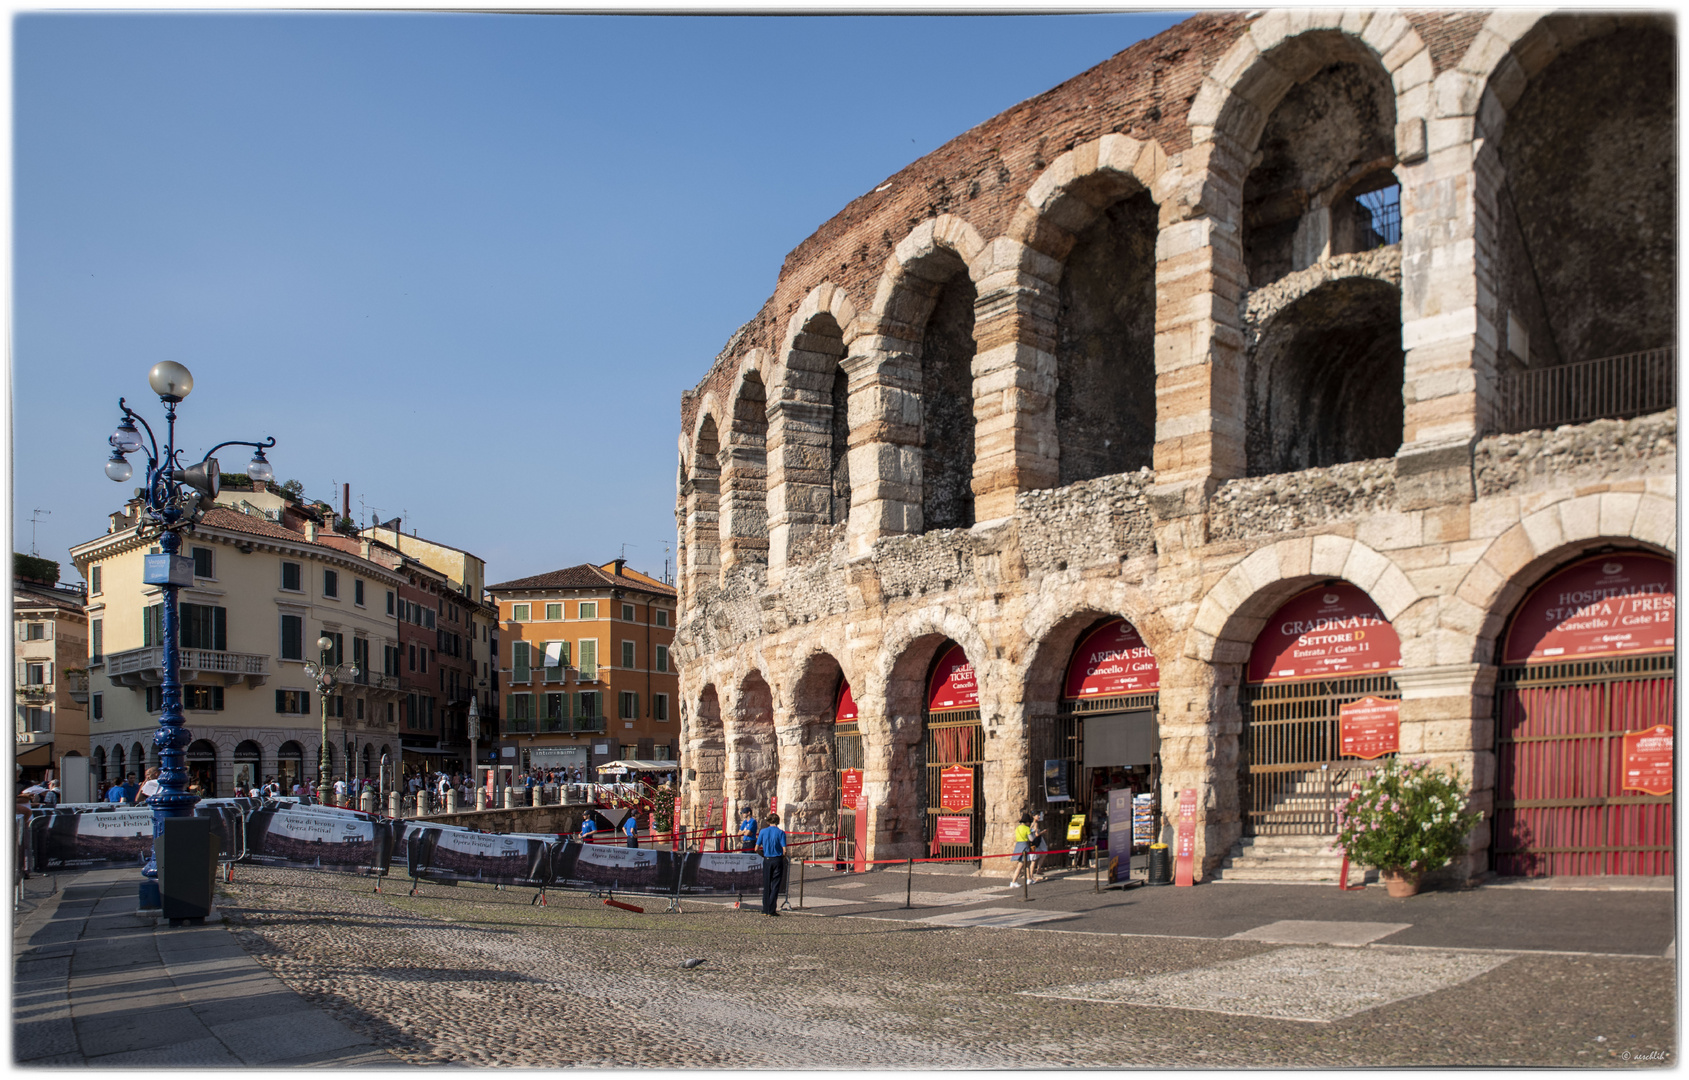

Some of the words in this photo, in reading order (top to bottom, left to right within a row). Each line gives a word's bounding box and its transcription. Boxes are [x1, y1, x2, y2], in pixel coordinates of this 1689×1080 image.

[1559, 583, 1667, 605] HOSPITALITY
[1545, 602, 1612, 621] STAMPA
[1281, 612, 1384, 636] GRADINATA
[1556, 618, 1608, 632] Cancello
[1622, 614, 1652, 626] Gate
[1654, 611, 1670, 622] 12
[1354, 630, 1365, 641] D
[1089, 650, 1130, 664] ARENA
[1293, 648, 1326, 658] Entrata
[1334, 645, 1357, 654] Gate
[1358, 642, 1369, 651] 11
[950, 671, 973, 682] TICKET
[1086, 664, 1123, 676] Cancello
[1132, 662, 1153, 671] Gate
[952, 681, 974, 689] Cancello
